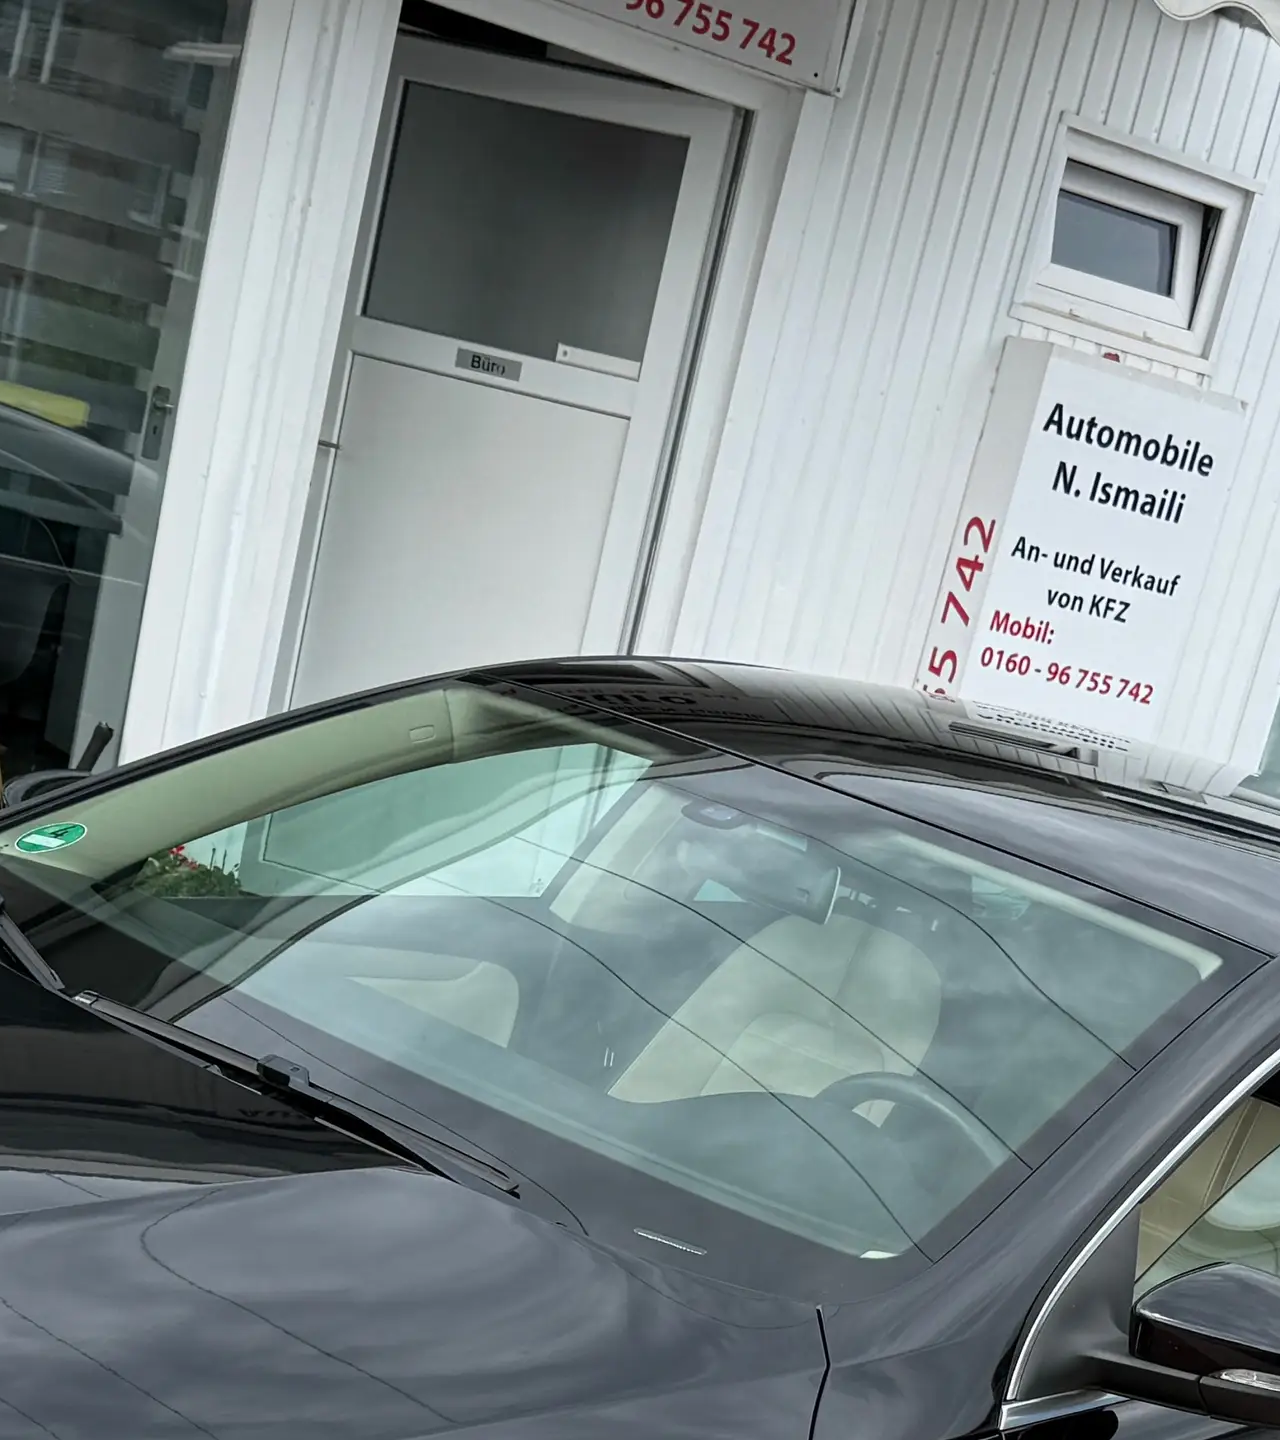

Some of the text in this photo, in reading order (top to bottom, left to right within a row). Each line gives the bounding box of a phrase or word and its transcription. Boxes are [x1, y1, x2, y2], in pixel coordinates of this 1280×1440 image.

[673, 0, 732, 41] 755
[739, 18, 796, 66] 742
[470, 353, 506, 376] Büro
[1042, 402, 1214, 477] Automobile
[1051, 460, 1187, 524] N. Ismaili
[940, 515, 996, 627] 742
[1010, 536, 1181, 597] An- und Verkauf
[989, 609, 1055, 645] Mobil:
[1046, 588, 1131, 623] von KFZ
[980, 646, 1031, 676] 0160
[1045, 662, 1071, 686] 96
[1075, 668, 1114, 696] 755
[1116, 678, 1154, 706] 742
